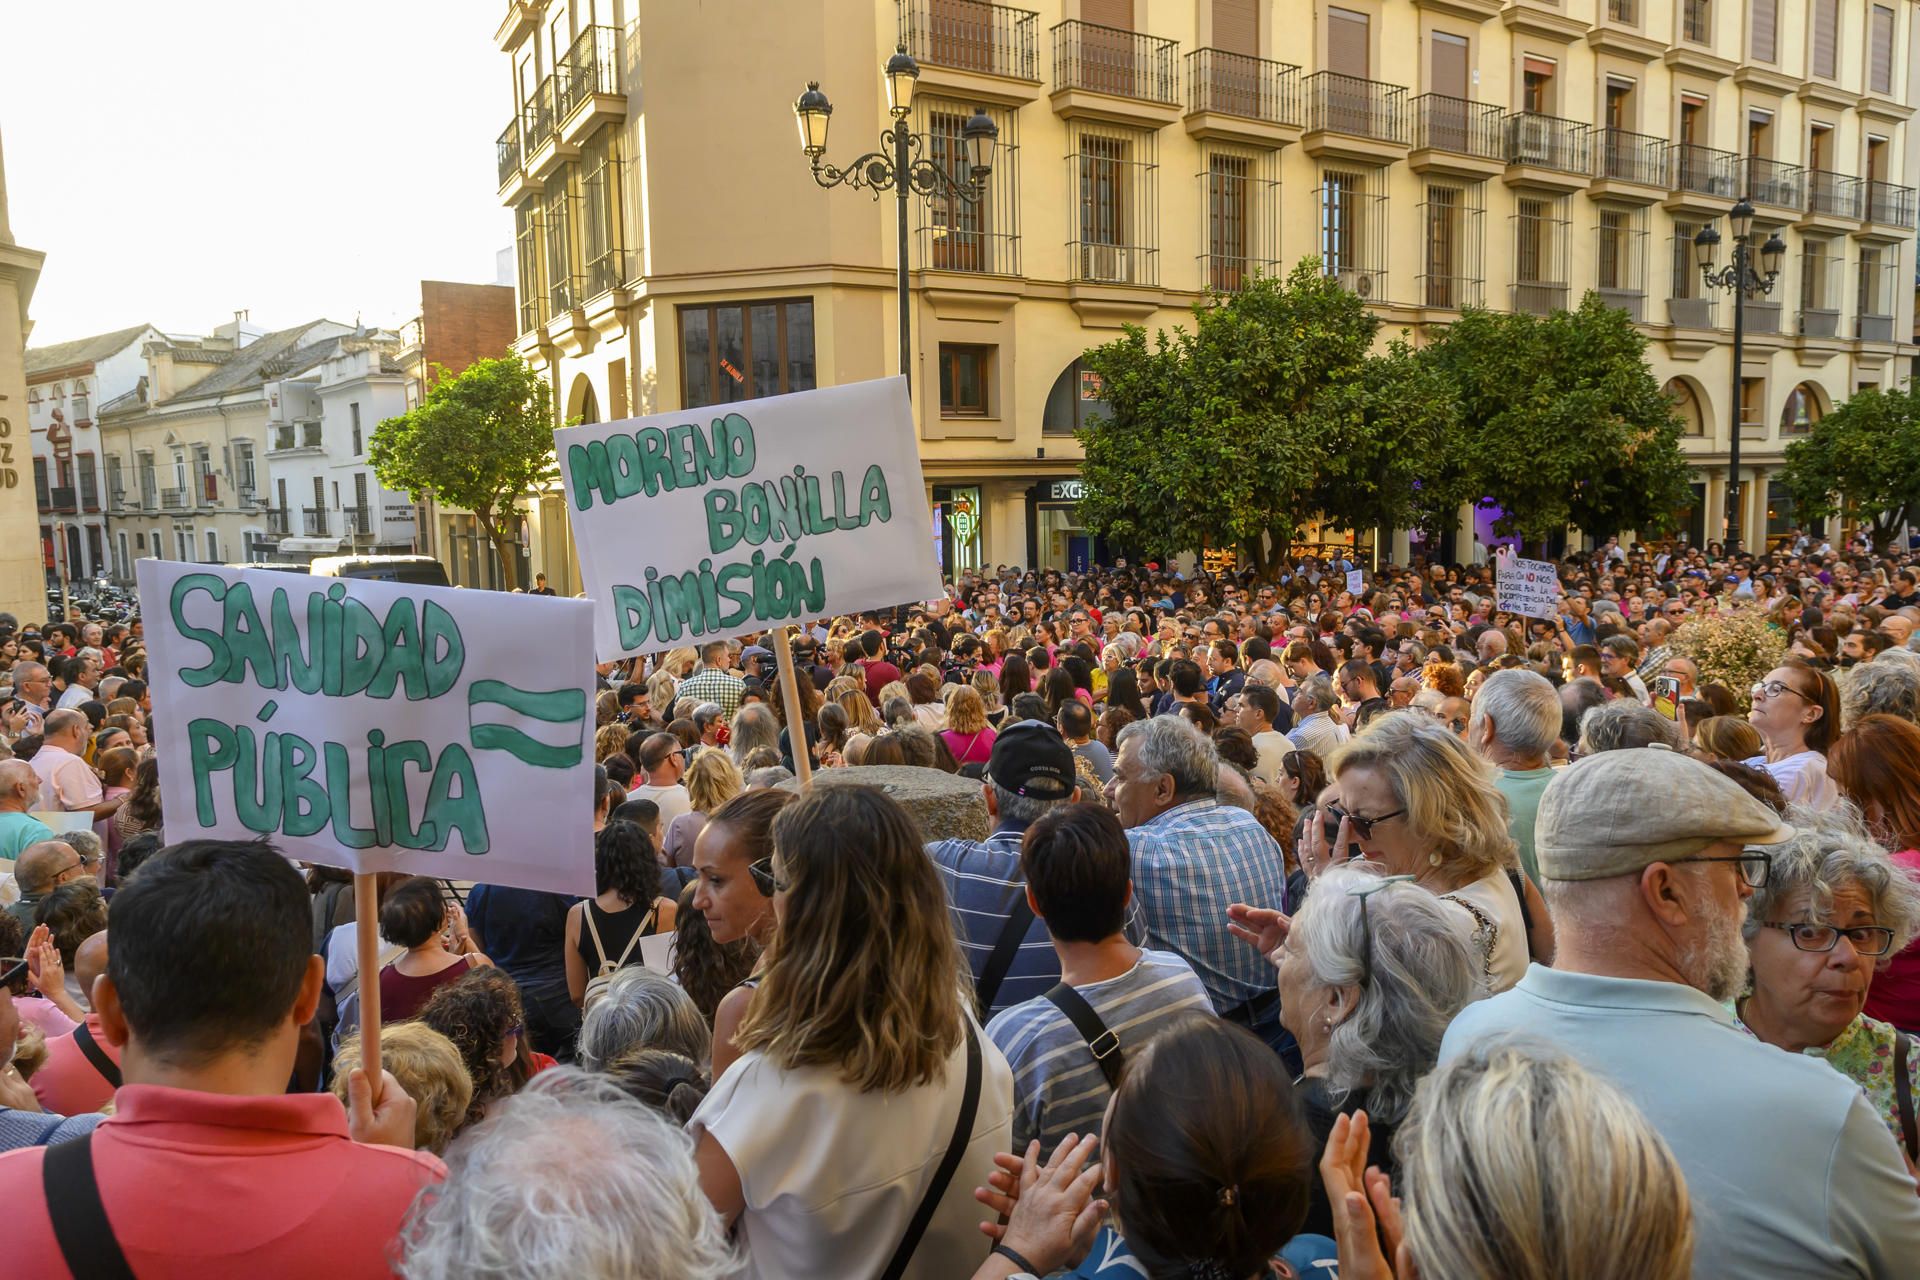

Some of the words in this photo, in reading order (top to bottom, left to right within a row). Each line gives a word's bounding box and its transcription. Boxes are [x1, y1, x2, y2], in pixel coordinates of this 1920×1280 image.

[568, 413, 756, 511] MORENO
[704, 464, 892, 554] BONILLA
[170, 573, 465, 700] SANIDAD
[612, 541, 827, 651] DIMISIÓN
[188, 700, 490, 854] PÚBLICA
